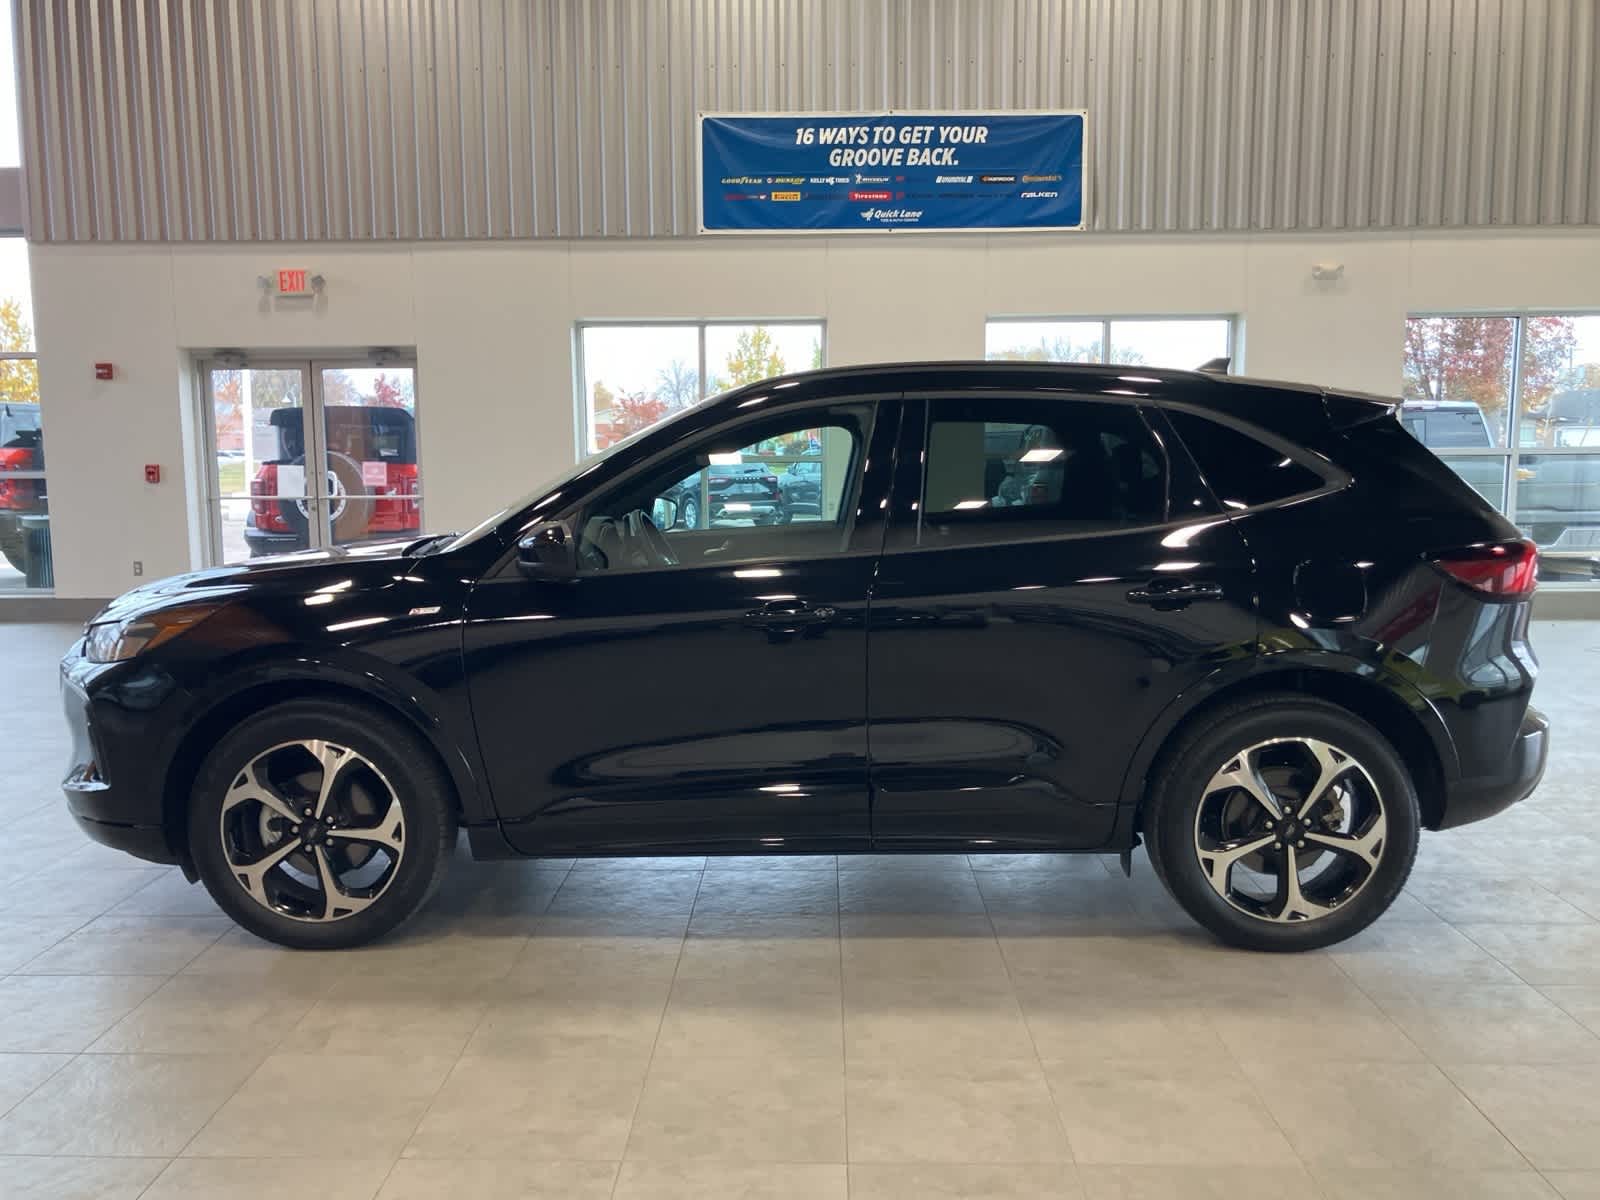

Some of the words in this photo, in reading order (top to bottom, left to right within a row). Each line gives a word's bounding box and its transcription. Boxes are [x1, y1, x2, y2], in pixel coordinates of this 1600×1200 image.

[795, 128, 815, 145] 16
[819, 126, 869, 145] WAYS
[873, 126, 896, 145] TO
[899, 126, 935, 144] GET
[939, 126, 988, 144] YOUR
[829, 148, 904, 167] GROOVE
[906, 147, 959, 166] BACK.
[874, 209, 899, 219] Quick
[899, 209, 923, 218] Lane
[279, 270, 305, 291] EXIT
